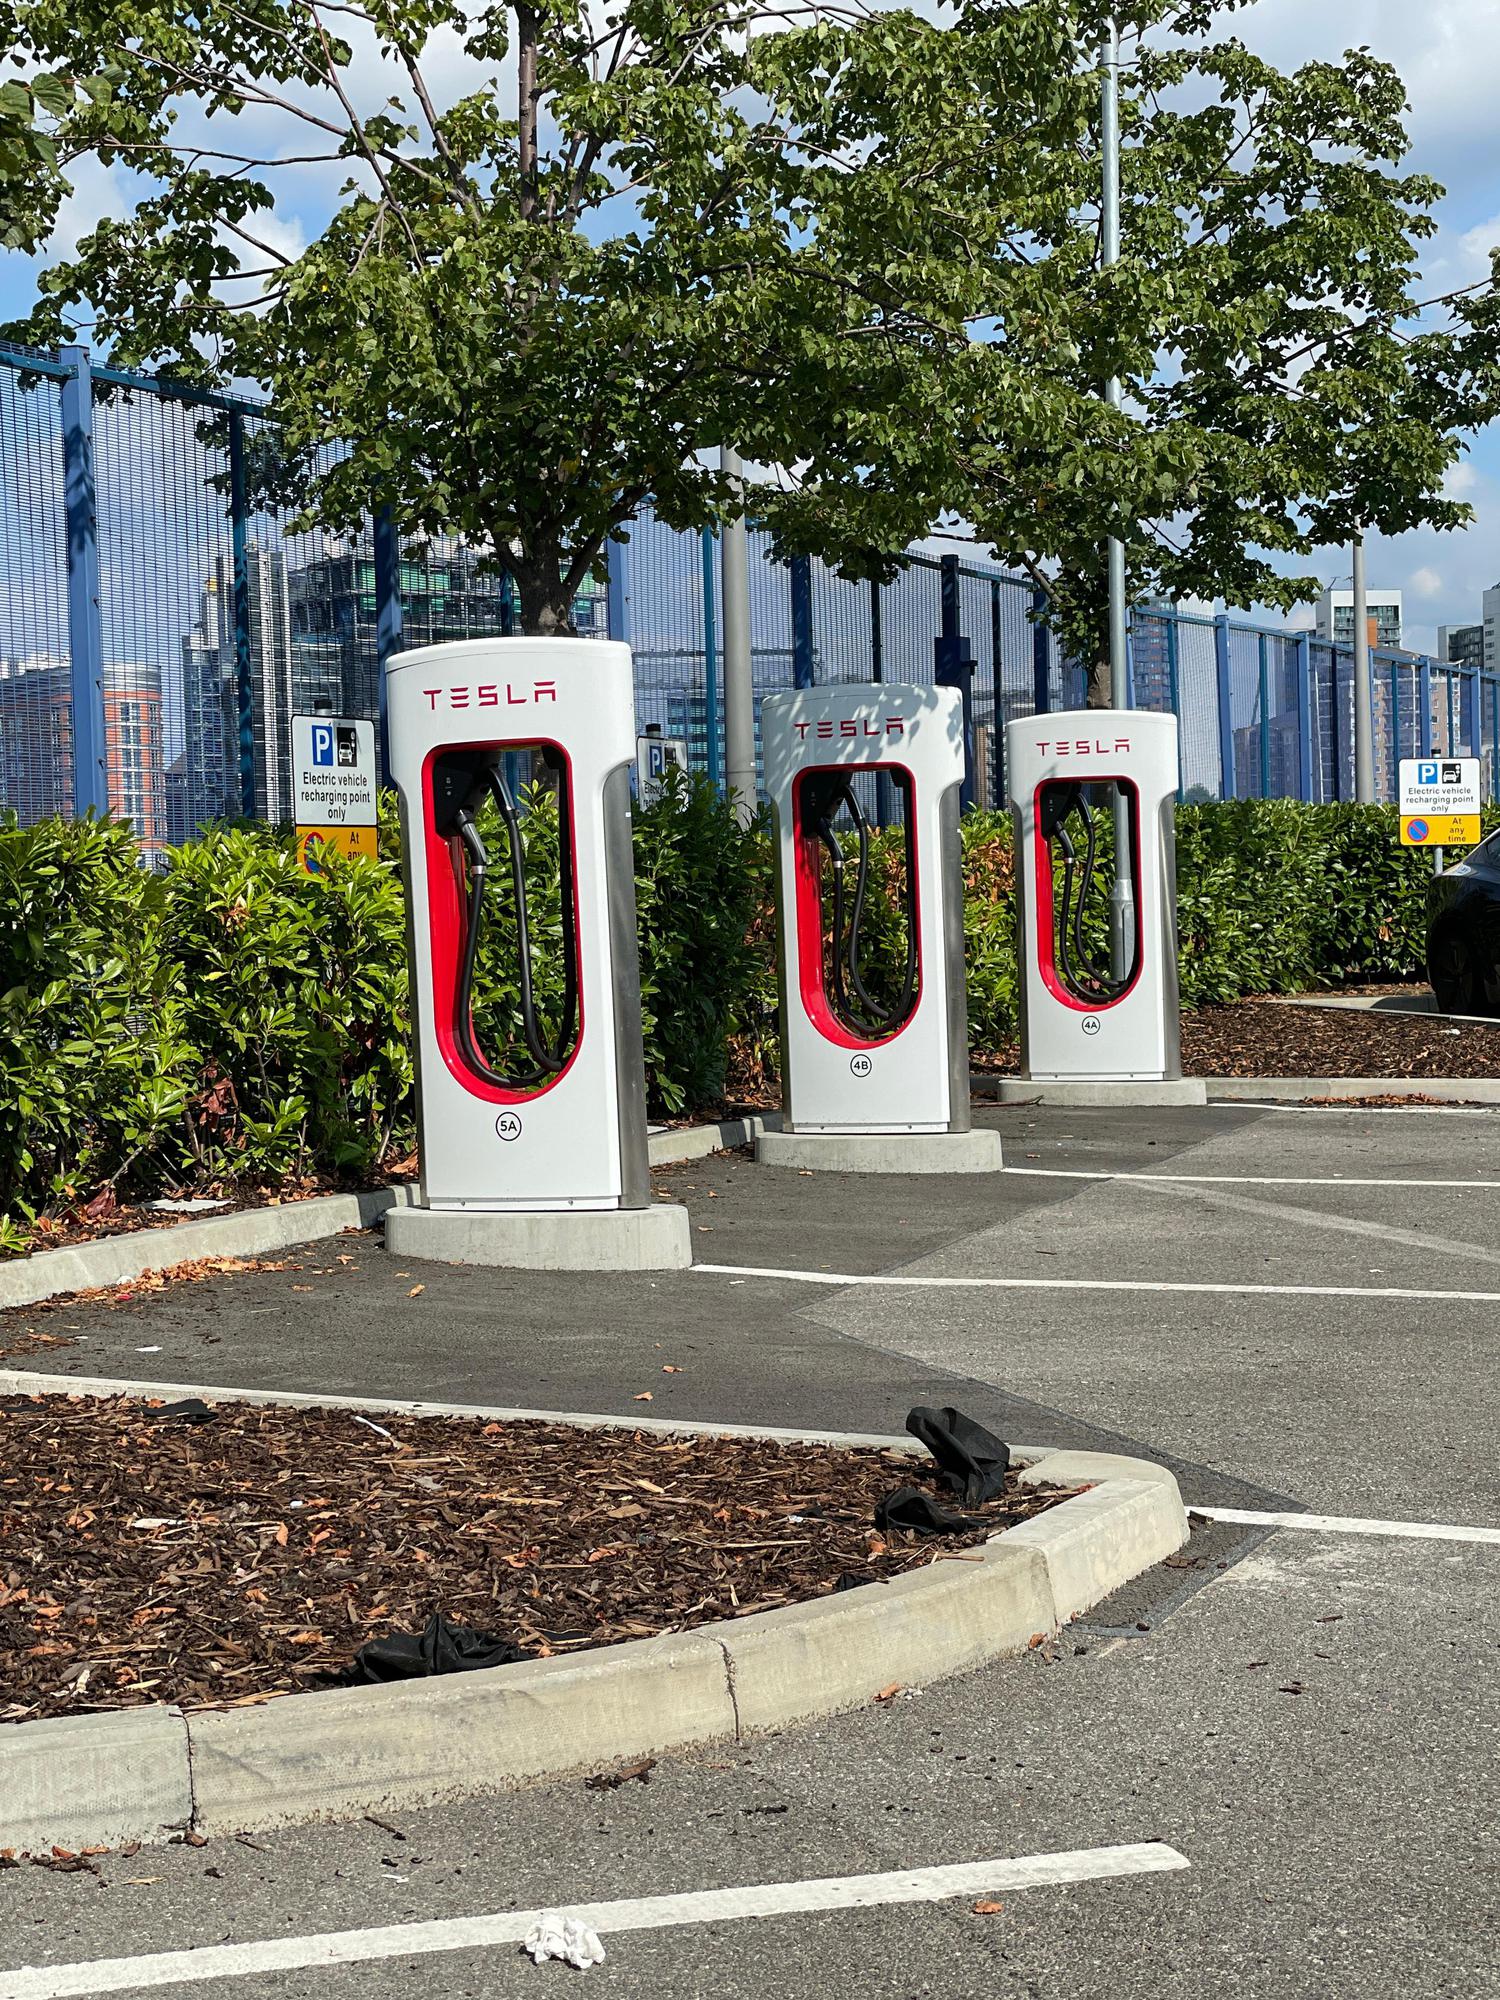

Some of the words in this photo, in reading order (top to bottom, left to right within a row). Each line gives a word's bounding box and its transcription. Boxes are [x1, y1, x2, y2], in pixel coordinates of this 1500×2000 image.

[422, 681, 556, 710] TESLA
[793, 717, 904, 740] TESLA
[315, 728, 330, 763] P
[1035, 738, 1130, 757] TESLA
[303, 771, 337, 786] Electric
[338, 773, 368, 787] vehicle
[1421, 765, 1435, 783] P
[301, 789, 347, 806] recharging
[349, 791, 371, 807] point
[1408, 787, 1440, 795] Electric
[1441, 787, 1472, 795] vehicle
[1405, 796, 1451, 805] recharging
[1452, 795, 1474, 804] point
[327, 806, 346, 822] only
[1431, 805, 1449, 813] only
[1452, 817, 1462, 825] At
[349, 831, 360, 845] At
[1449, 827, 1465, 835] any
[1084, 1021, 1098, 1029] 4A
[853, 1060, 869, 1070] 4B
[500, 1120, 518, 1132] 5A
